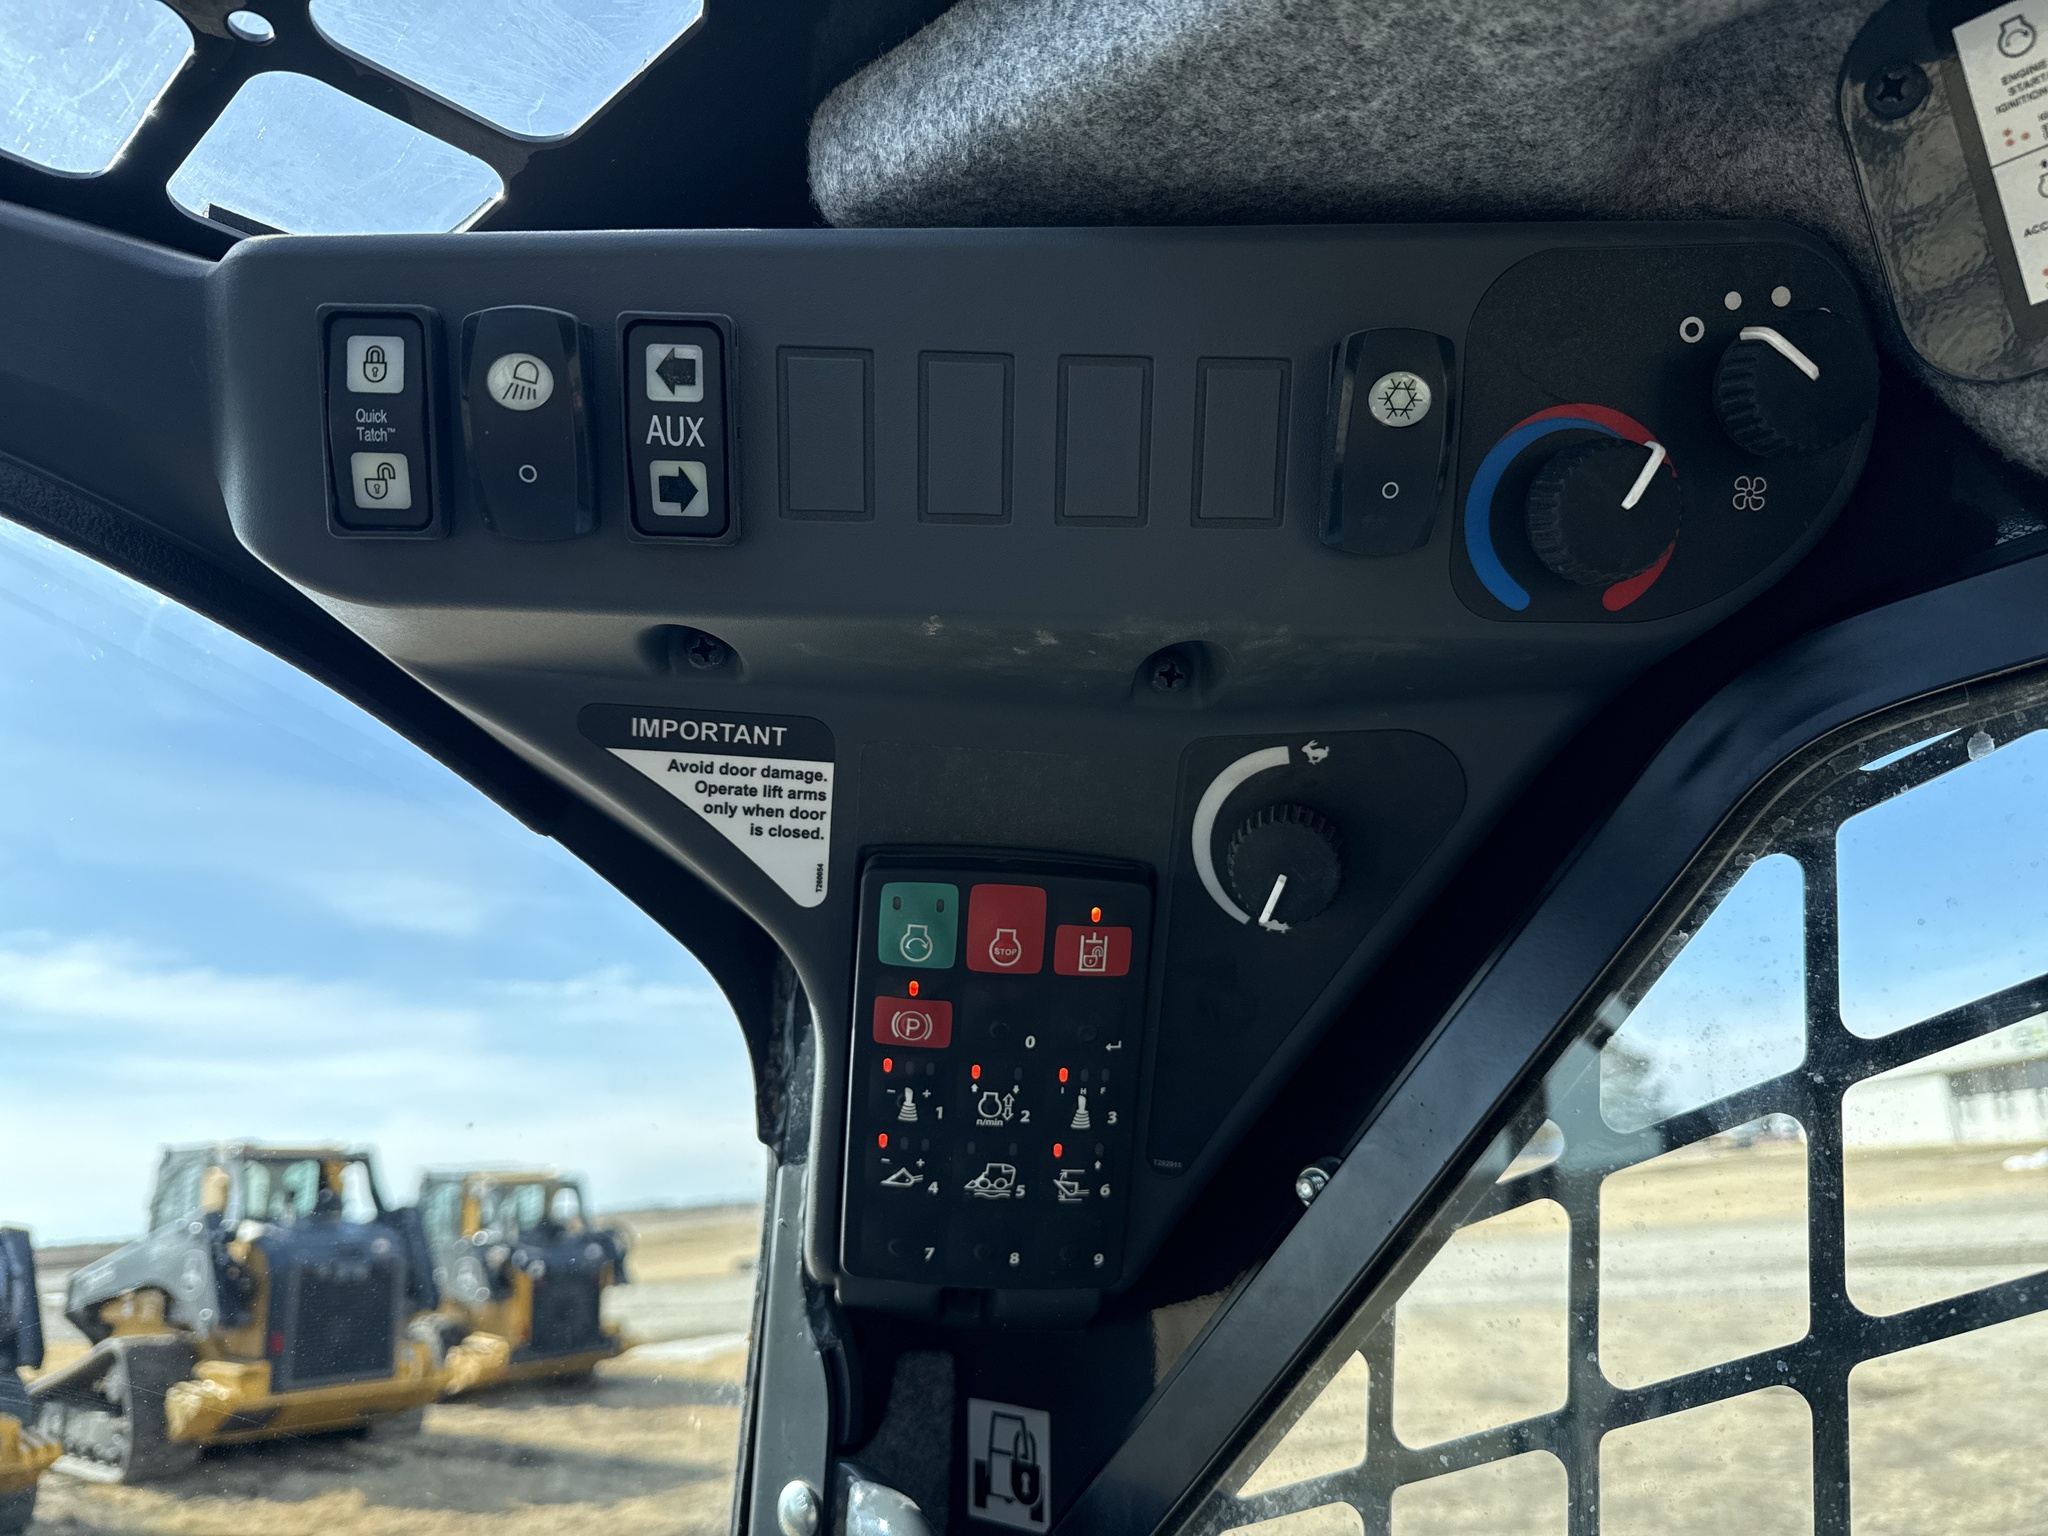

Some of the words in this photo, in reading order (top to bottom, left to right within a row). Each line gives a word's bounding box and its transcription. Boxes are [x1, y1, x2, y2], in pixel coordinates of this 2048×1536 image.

[355, 408, 388, 424] Quick
[646, 415, 705, 448] AUX
[631, 717, 788, 747] IMPORTANT
[667, 758, 714, 775] Avoid
[719, 762, 757, 778] door
[761, 765, 828, 783] damage.
[695, 780, 758, 798] Operate
[763, 784, 783, 799] lift
[787, 788, 827, 802] arms
[703, 802, 738, 818] only
[742, 804, 785, 818] when
[789, 807, 827, 821] door
[750, 823, 764, 837] is
[768, 825, 825, 841] closed.
[994, 947, 1018, 956] STOP
[905, 1017, 920, 1037] P
[1024, 1035, 1036, 1050] 0
[935, 1106, 943, 1119] 1
[1019, 1109, 1031, 1123] 2
[1106, 1110, 1118, 1125] 3
[975, 1117, 1004, 1127] n/min
[927, 1181, 939, 1195] 4
[1014, 1184, 1026, 1198] 5
[1099, 1183, 1111, 1197] 6
[924, 1247, 935, 1261] 7
[1009, 1252, 1020, 1266] 8
[1093, 1253, 1104, 1267] 9
